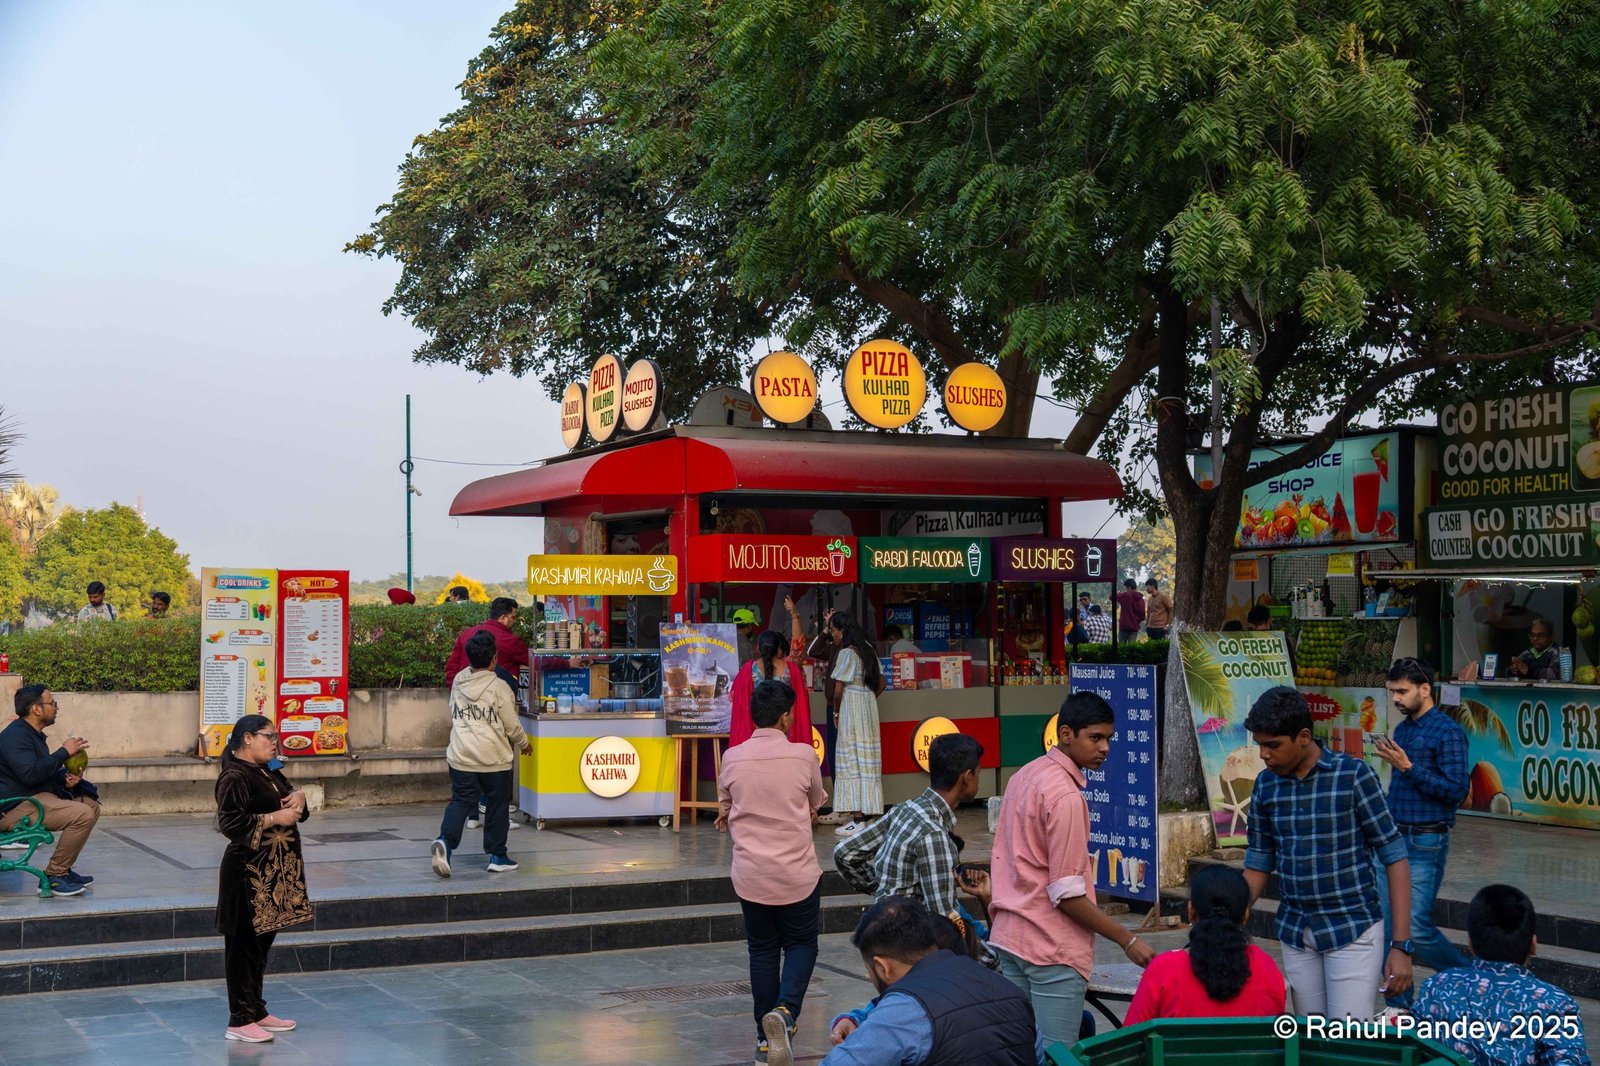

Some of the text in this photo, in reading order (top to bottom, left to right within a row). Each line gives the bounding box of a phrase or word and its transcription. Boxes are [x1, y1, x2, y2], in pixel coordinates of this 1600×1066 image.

[861, 350, 909, 377] PIZZA
[593, 362, 615, 394] PIZZA
[625, 377, 654, 396] MOJITO
[760, 376, 812, 398] PASTA
[863, 378, 910, 396] KULHAD
[592, 390, 614, 413] KULHAD
[624, 396, 653, 412] SLUSHES
[948, 384, 1003, 409] SLUSHES
[882, 399, 911, 416] PIZZA
[1441, 391, 1563, 436] GO FRESH
[600, 409, 614, 429] PIZZA
[1296, 453, 1342, 469] UICE
[1443, 433, 1569, 476] COCONUT
[1268, 477, 1315, 494] SHOP
[1441, 472, 1569, 498] GOOD FOR HEALTH
[1438, 513, 1462, 532] CASH
[1473, 503, 1588, 532] GO FRESH
[1431, 537, 1472, 557] COUNTER
[1477, 532, 1584, 560] COCONUT
[729, 544, 829, 571] MOJITO SLUSHES
[874, 549, 964, 568] RABDI FALOODA
[1011, 547, 1074, 570] SLUSHIES
[219, 578, 262, 587] COOL DRINKS
[530, 566, 645, 586] KASHMIRI KAHWA
[894, 610, 912, 621] pepsi
[931, 615, 950, 623] ENJO
[664, 636, 736, 654] KASHMIRI KAHWA
[1217, 637, 1284, 656] GO FRESH
[1071, 666, 1149, 679] Mausami Juice 70/- 100/-
[1222, 661, 1288, 679] COCONUT
[1127, 688, 1136, 699] 70/-
[1137, 688, 1149, 699] 100/-
[1127, 709, 1152, 721] 150/- 200/-
[1313, 703, 1335, 714] LIST
[1517, 701, 1550, 747] GO
[1127, 730, 1137, 742] 80/-
[1137, 730, 1150, 742] 120/-
[585, 753, 635, 766] KASHMIRI
[1127, 751, 1150, 764] 70/- 90/-
[591, 768, 628, 781] KAHWA
[1127, 772, 1138, 784] 60/-
[1080, 788, 1148, 806] mon Soda 70/- 90/-
[1089, 809, 1151, 828] uice 80/- 120/-
[1088, 830, 1151, 850] melon Juice 70/- 90/-
